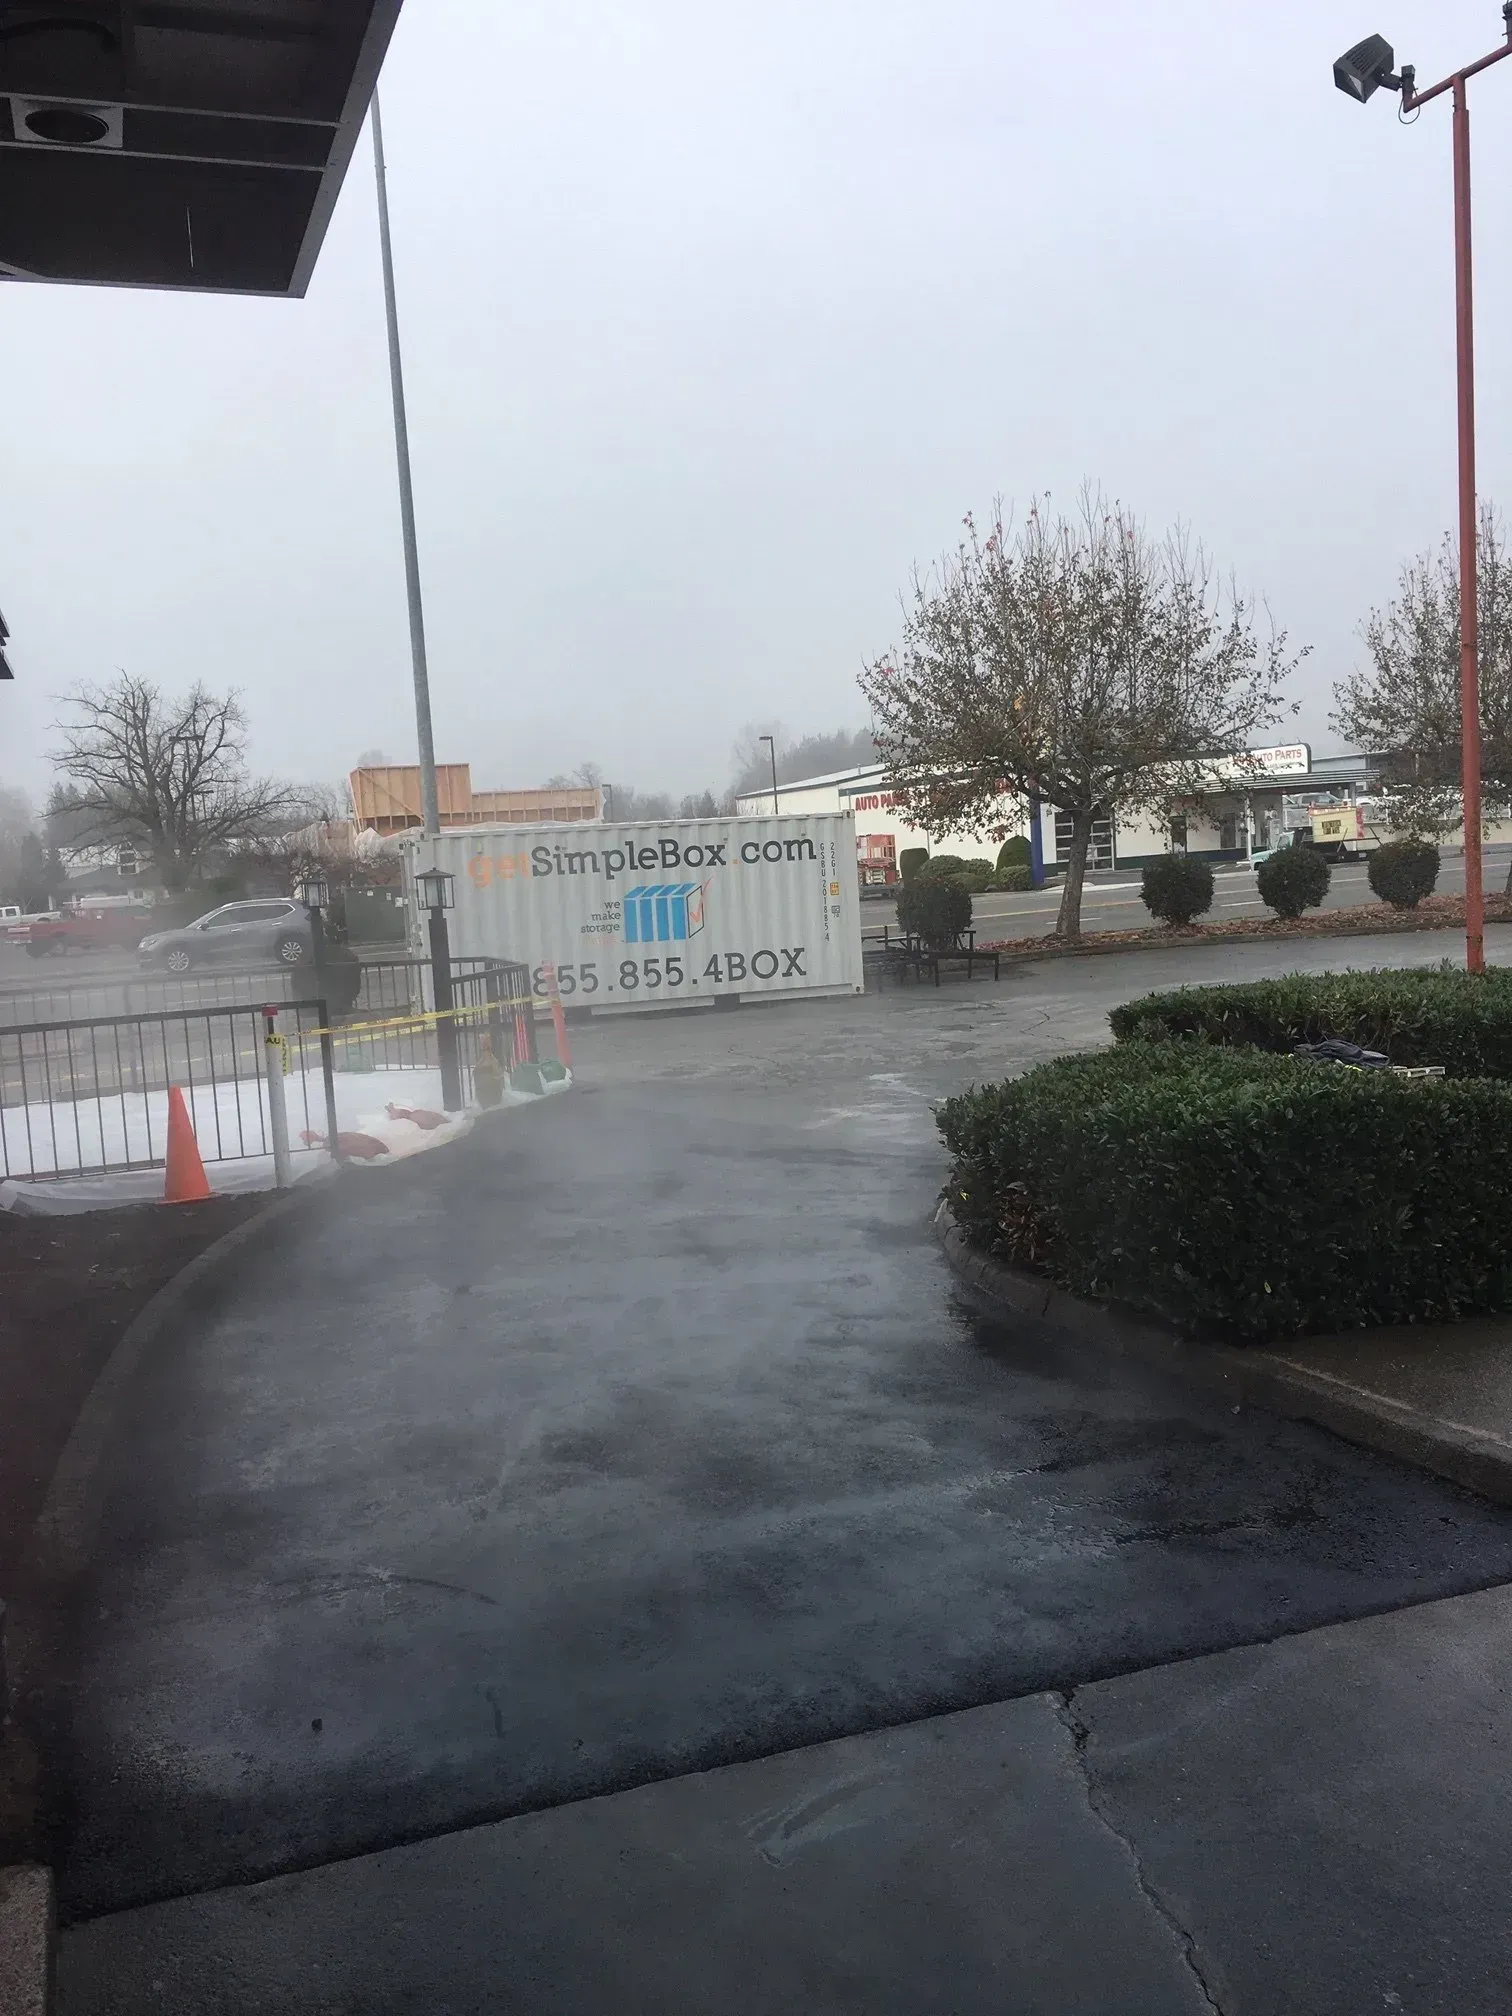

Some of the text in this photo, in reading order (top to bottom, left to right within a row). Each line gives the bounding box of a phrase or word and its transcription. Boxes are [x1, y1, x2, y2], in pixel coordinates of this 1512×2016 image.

[1275, 749, 1302, 761] PARTS
[855, 794, 879, 812] AUTO
[604, 901, 621, 909] we
[591, 911, 622, 921] make
[580, 923, 621, 934] storage
